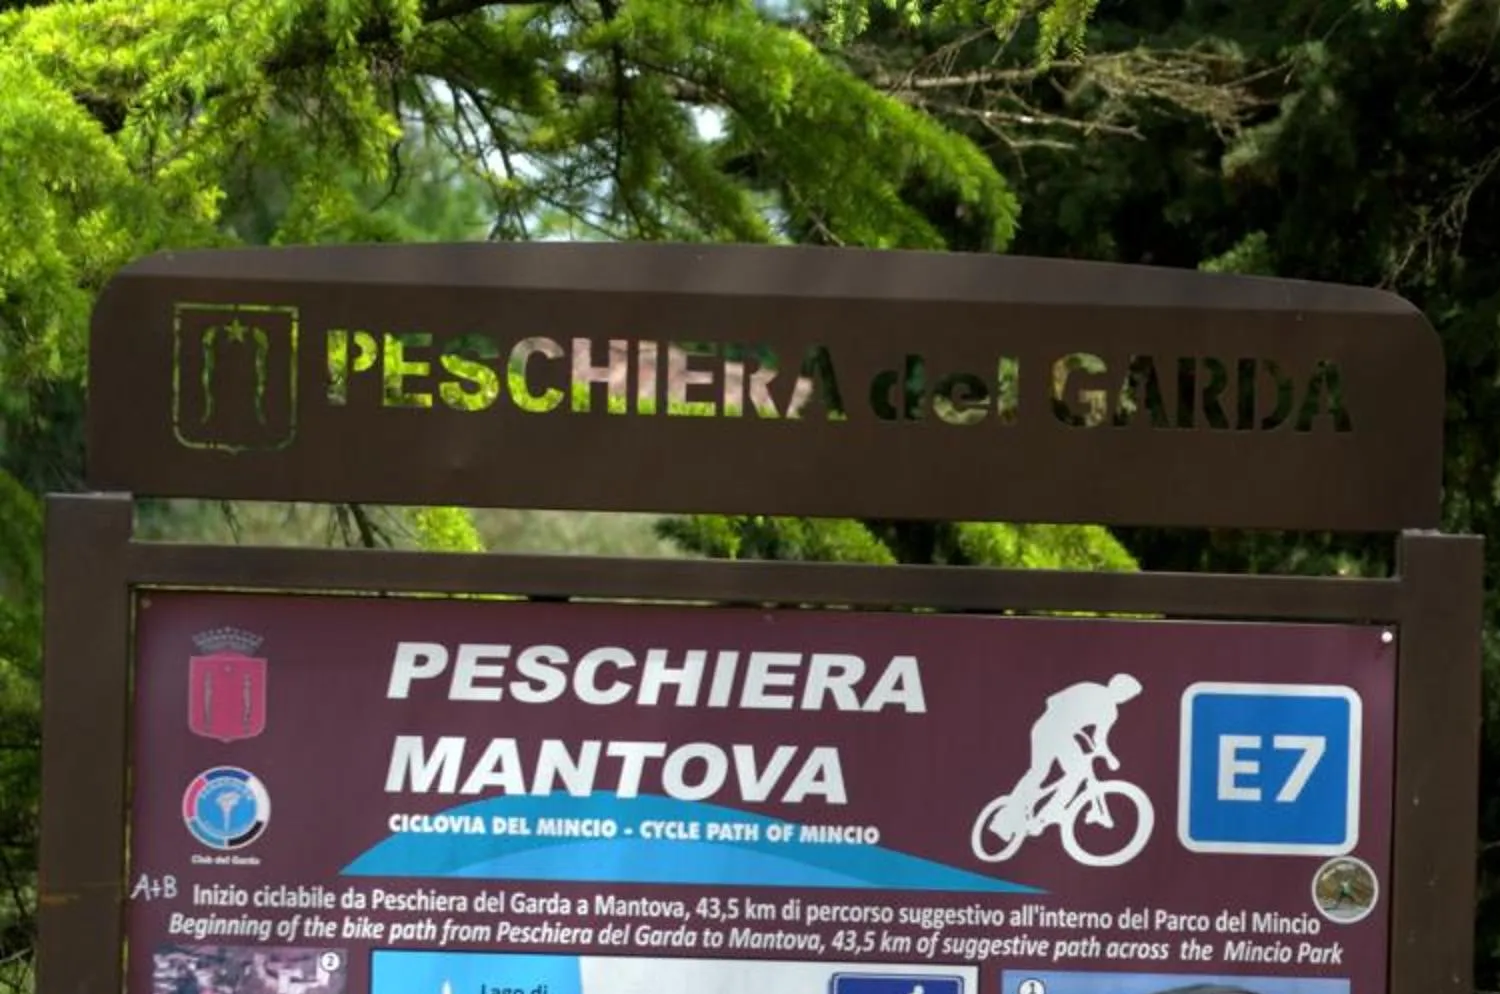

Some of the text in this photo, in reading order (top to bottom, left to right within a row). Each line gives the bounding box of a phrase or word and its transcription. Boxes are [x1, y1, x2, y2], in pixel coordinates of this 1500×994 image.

[326, 329, 1352, 432] PESCHIERA del GARDA
[387, 641, 926, 713] PESCHIERA
[384, 736, 848, 805] MANTOVA
[1217, 733, 1326, 803] E7
[389, 813, 879, 845] CICLOVIA DEL MINCIO CYCLE PATH OF MINCIO
[169, 912, 1343, 965] Beginning of the bike path from Peschiera del Garda to Mantova, 43,5 km of suggestive path across the Mincio Park
[193, 884, 1320, 934] Inizio ciclabile da Peschiera del Garda a Mantova, 43,5 km di percorso suggestivo all'interno del Parco del Mincio
